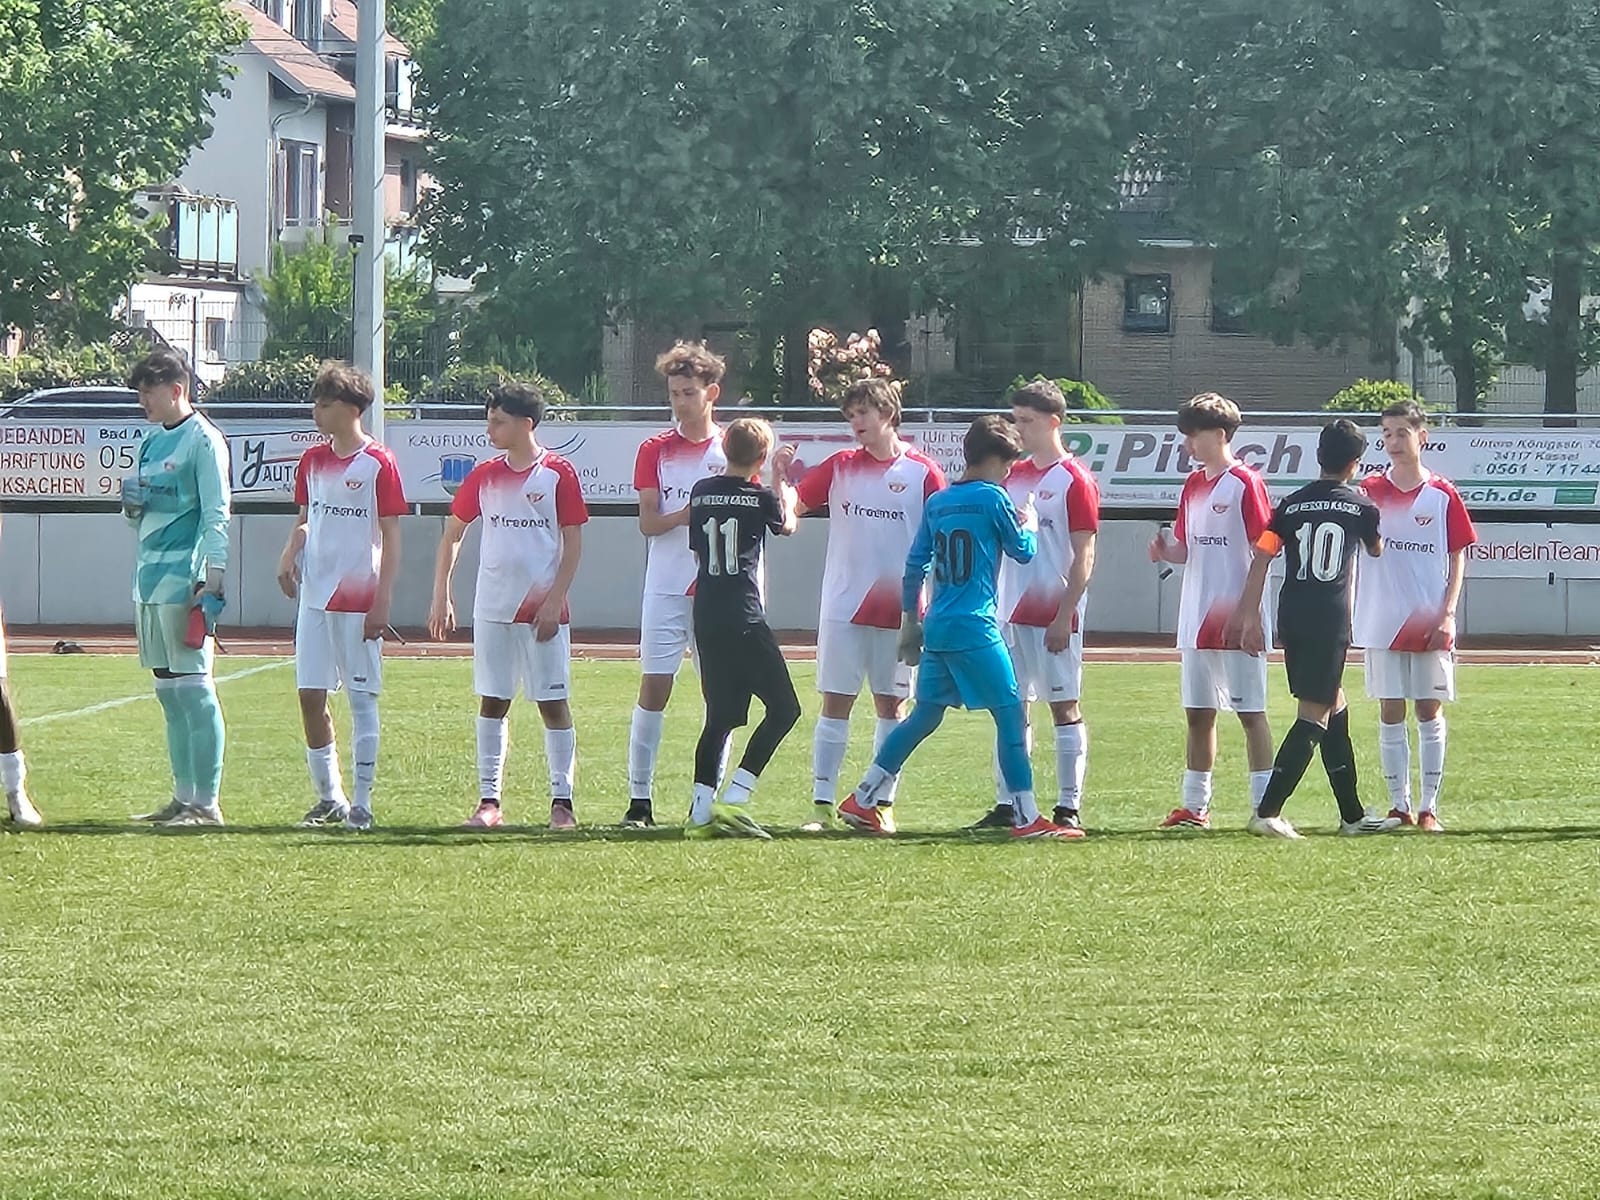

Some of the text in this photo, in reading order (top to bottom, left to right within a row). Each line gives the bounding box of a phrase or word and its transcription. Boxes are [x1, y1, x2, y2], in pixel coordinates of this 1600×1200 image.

[100, 428, 127, 439] Bad
[1115, 432, 1303, 474] Pitch
[1486, 463, 1528, 475] 0561
[702, 516, 740, 576] 11
[1295, 521, 1345, 582] 10
